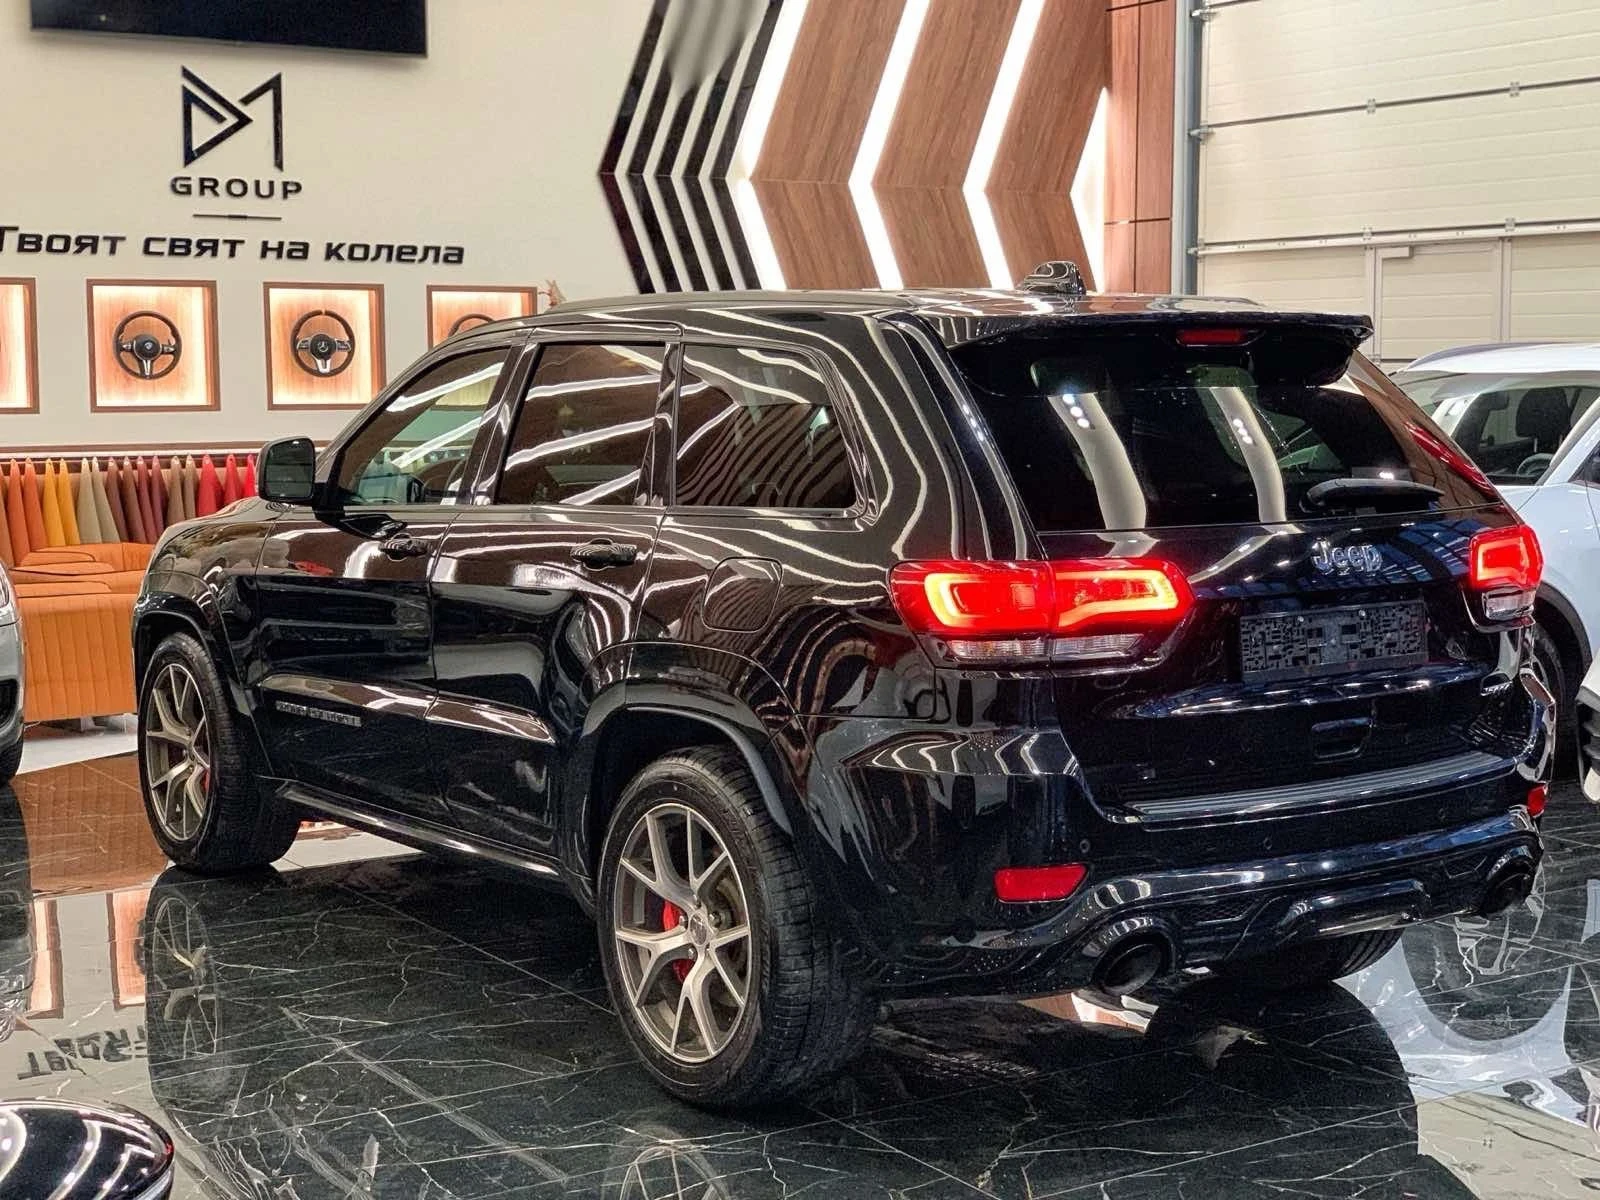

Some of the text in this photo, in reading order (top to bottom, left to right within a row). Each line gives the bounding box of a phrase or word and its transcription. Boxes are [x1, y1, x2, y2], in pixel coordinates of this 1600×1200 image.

[170, 176, 303, 200] GROUP
[142, 236, 246, 259] свят
[260, 240, 310, 260] на
[324, 242, 465, 265] колела
[1311, 540, 1383, 575] Jeep
